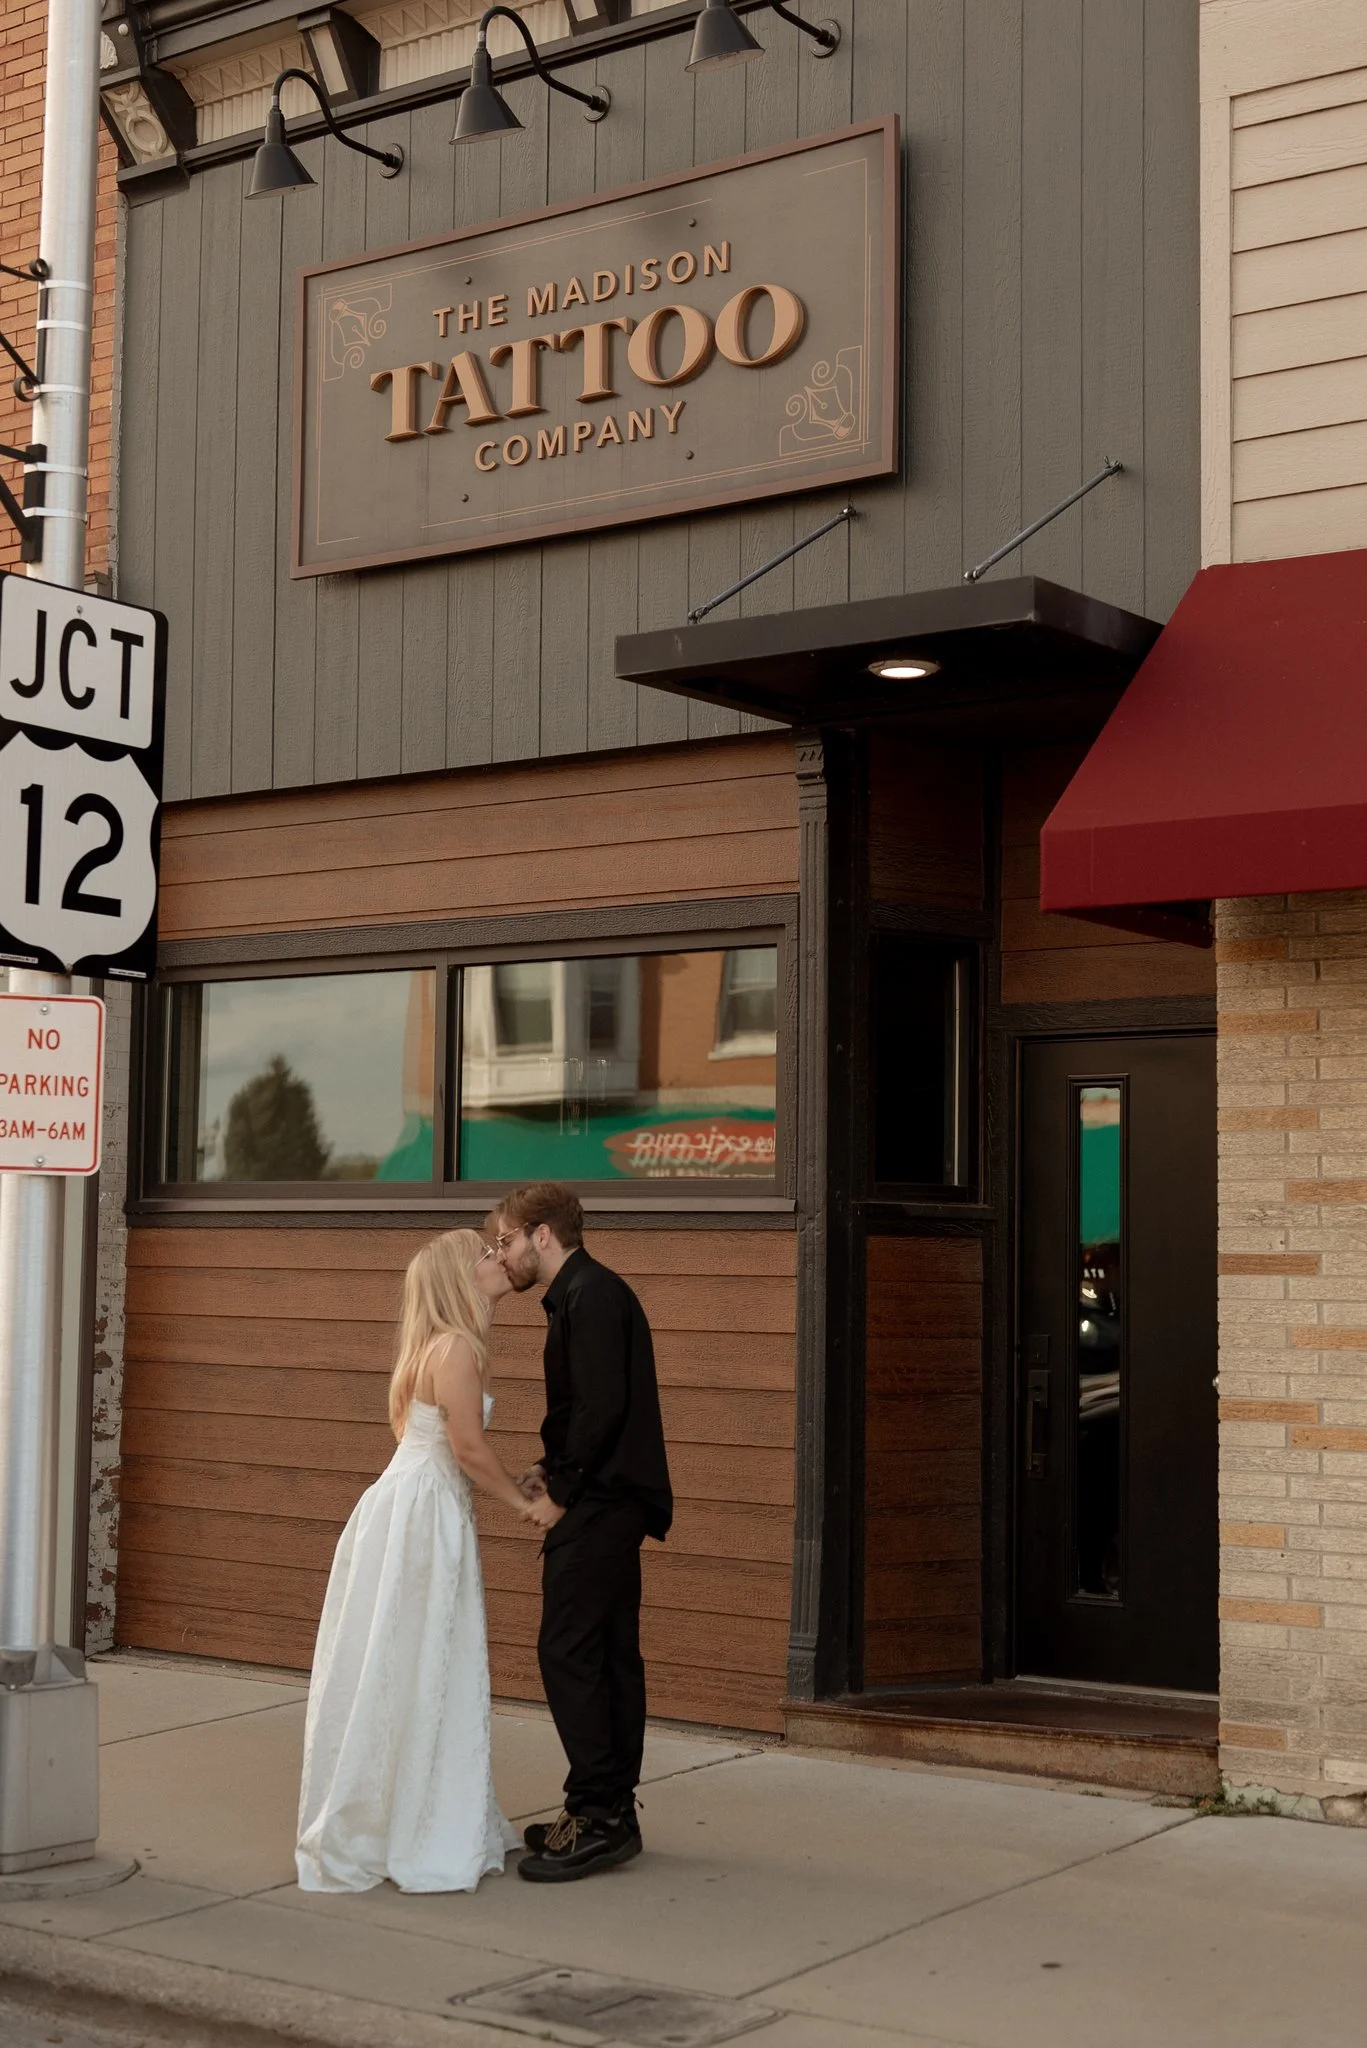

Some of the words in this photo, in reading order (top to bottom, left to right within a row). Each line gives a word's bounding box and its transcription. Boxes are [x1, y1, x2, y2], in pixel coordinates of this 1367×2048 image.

[433, 293, 508, 337] THE
[527, 241, 731, 318] MADISON
[370, 283, 806, 442] TATTOO
[474, 400, 687, 472] COMPANY
[10, 609, 144, 720] JCT
[20, 783, 124, 918] 12
[0, 1073, 90, 1098] PARKING
[27, 1028, 61, 1051] NO
